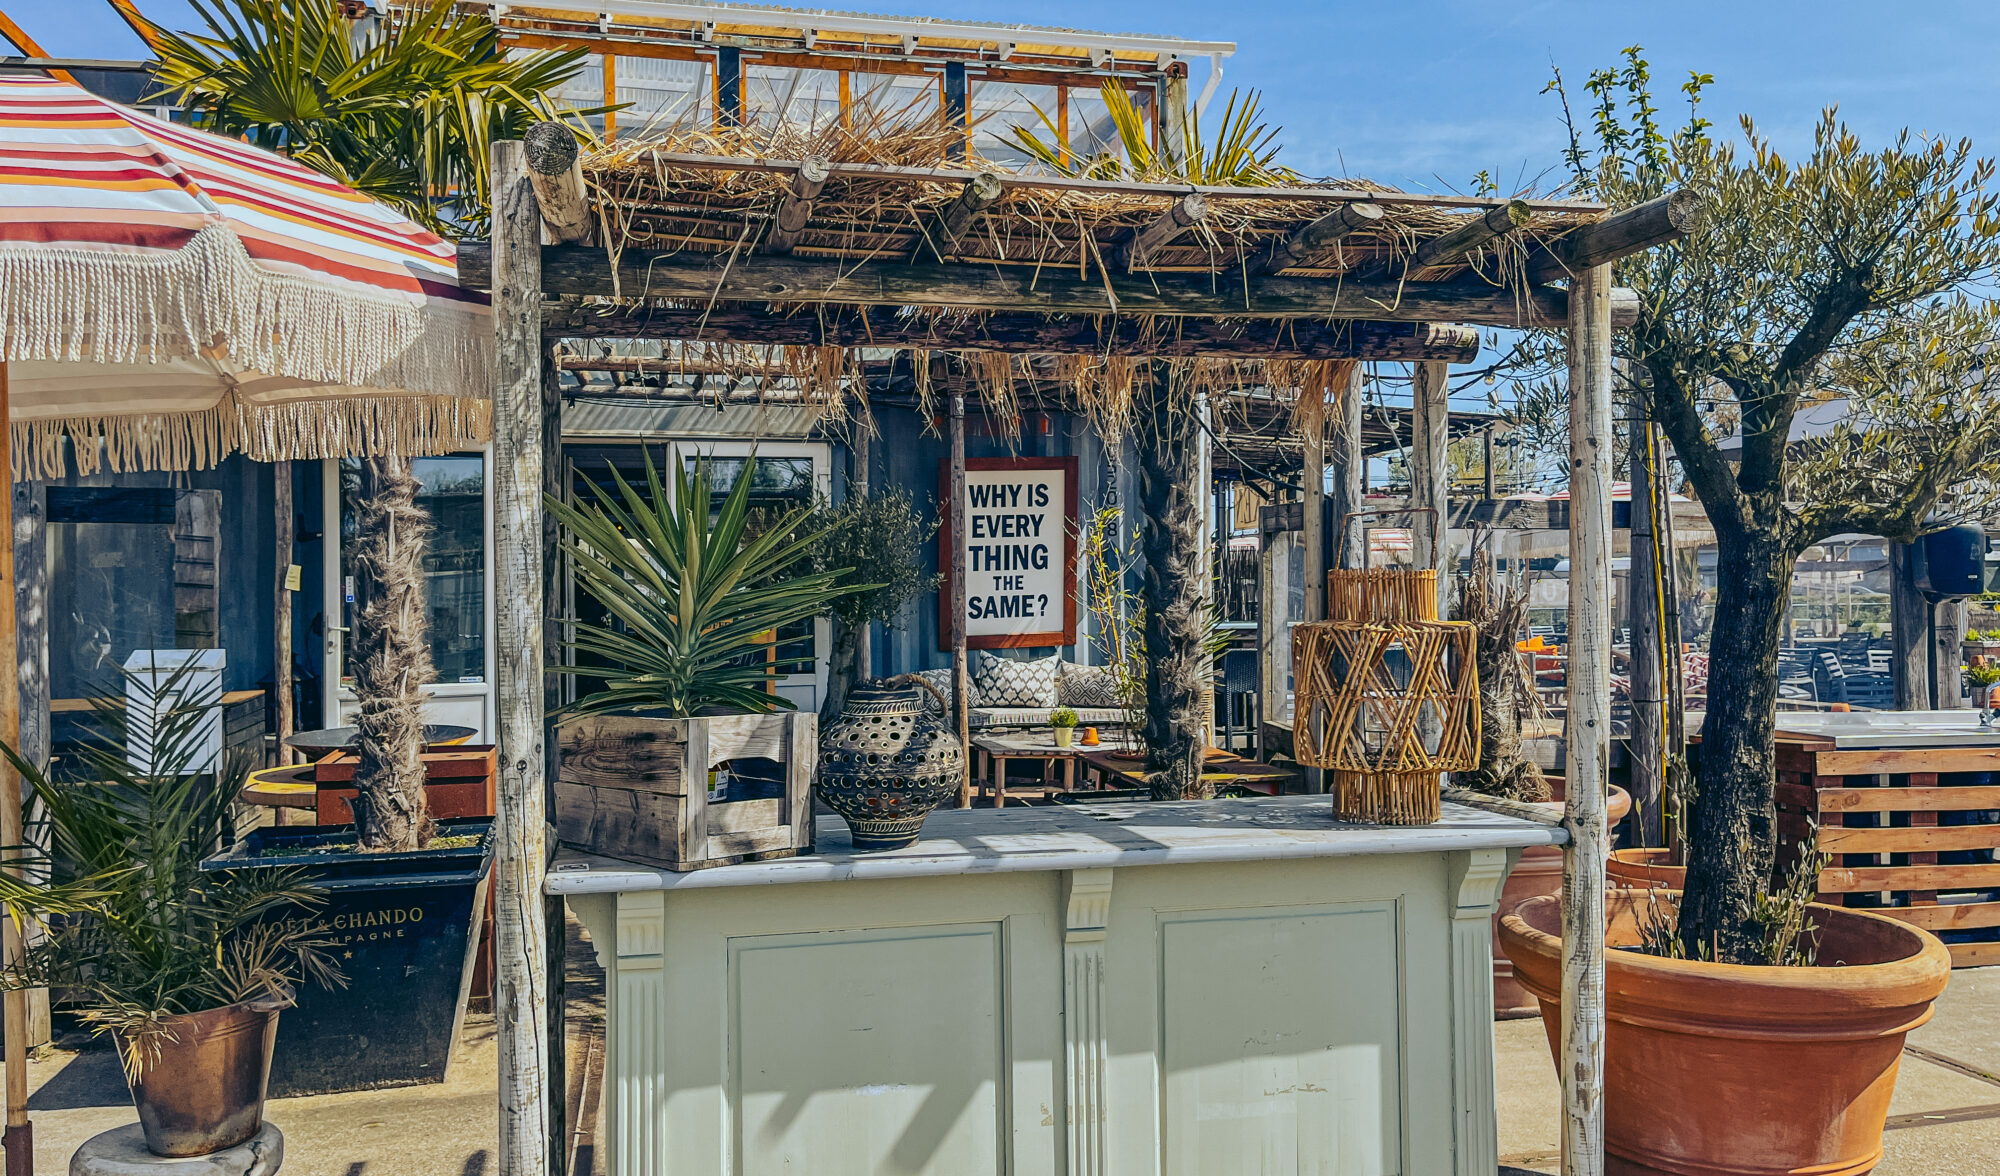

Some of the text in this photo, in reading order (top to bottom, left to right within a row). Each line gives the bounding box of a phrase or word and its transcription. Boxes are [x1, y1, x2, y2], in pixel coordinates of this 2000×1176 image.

[968, 483, 1049, 508] WHY IS
[971, 514, 1044, 539] EVERY
[968, 543, 1048, 572] THING
[993, 575, 1024, 591] THE
[968, 594, 1049, 620] SAME?
[318, 919, 329, 930] &
[334, 907, 423, 929] CHANDO
[329, 929, 405, 944] MPAGNE
